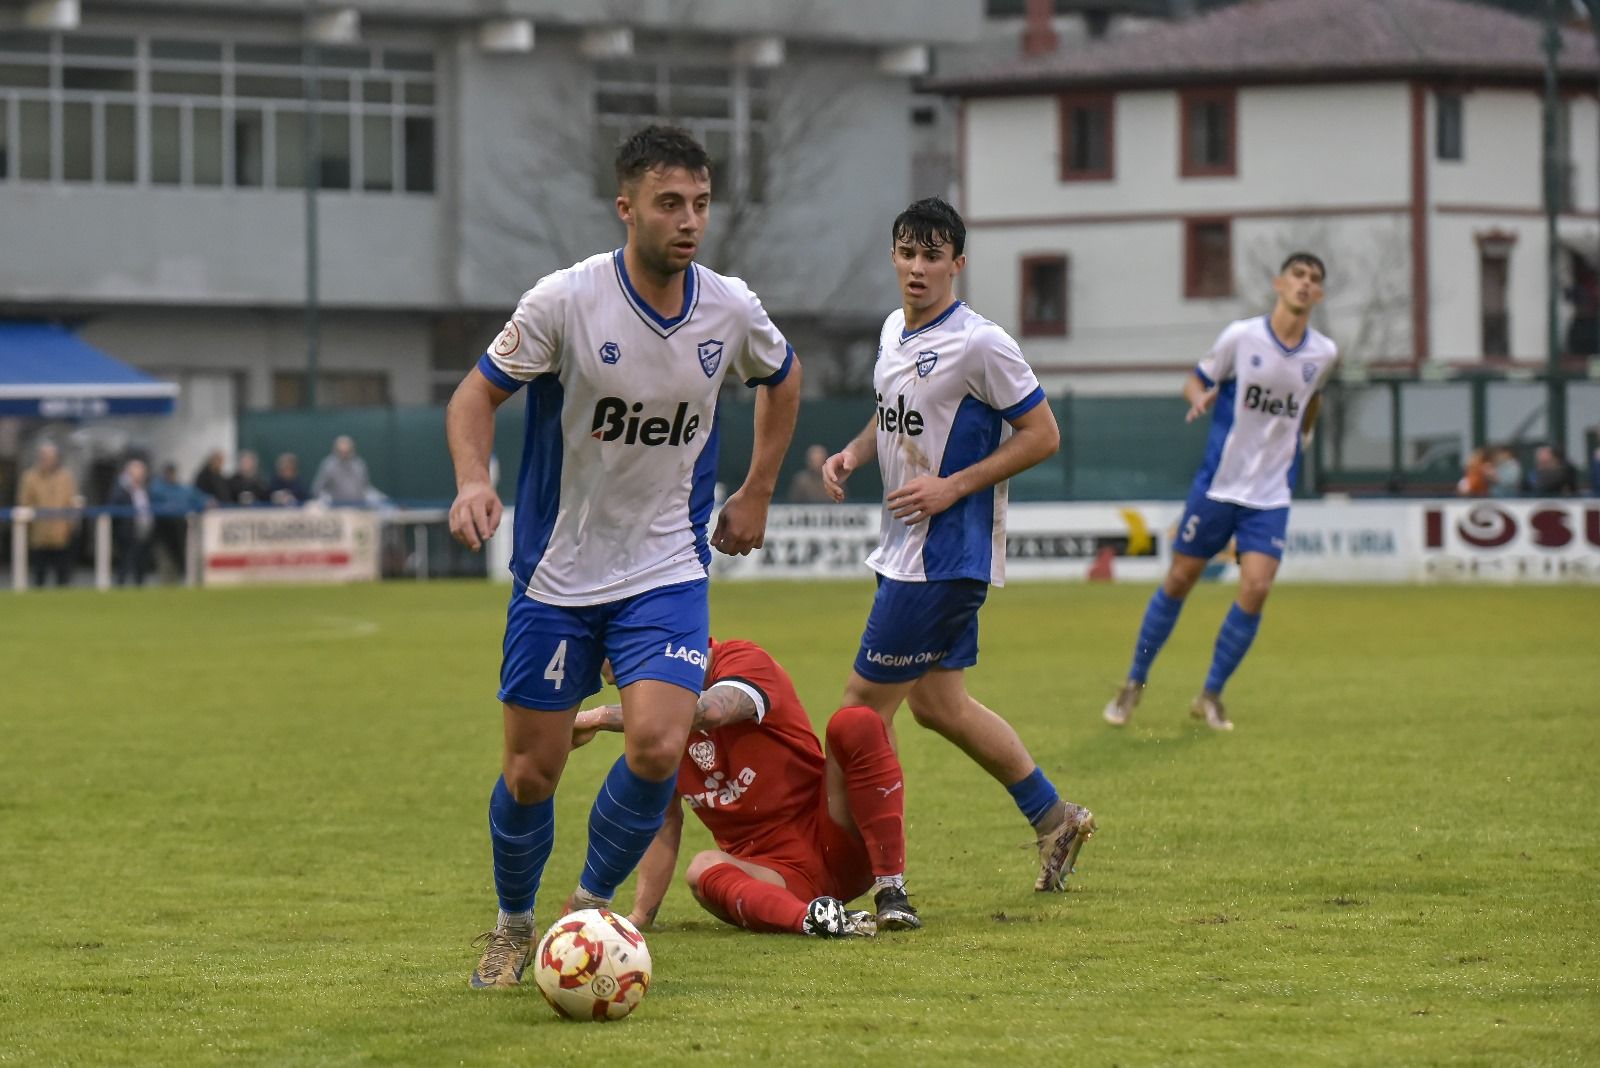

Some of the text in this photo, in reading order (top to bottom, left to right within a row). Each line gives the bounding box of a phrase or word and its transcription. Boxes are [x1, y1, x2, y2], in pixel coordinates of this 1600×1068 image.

[591, 397, 700, 447] Biele
[876, 391, 923, 435] iele
[1181, 514, 1200, 543] 5
[1425, 554, 1600, 576] OPTIK
[543, 639, 567, 690] 4
[866, 648, 913, 666] LAGUN
